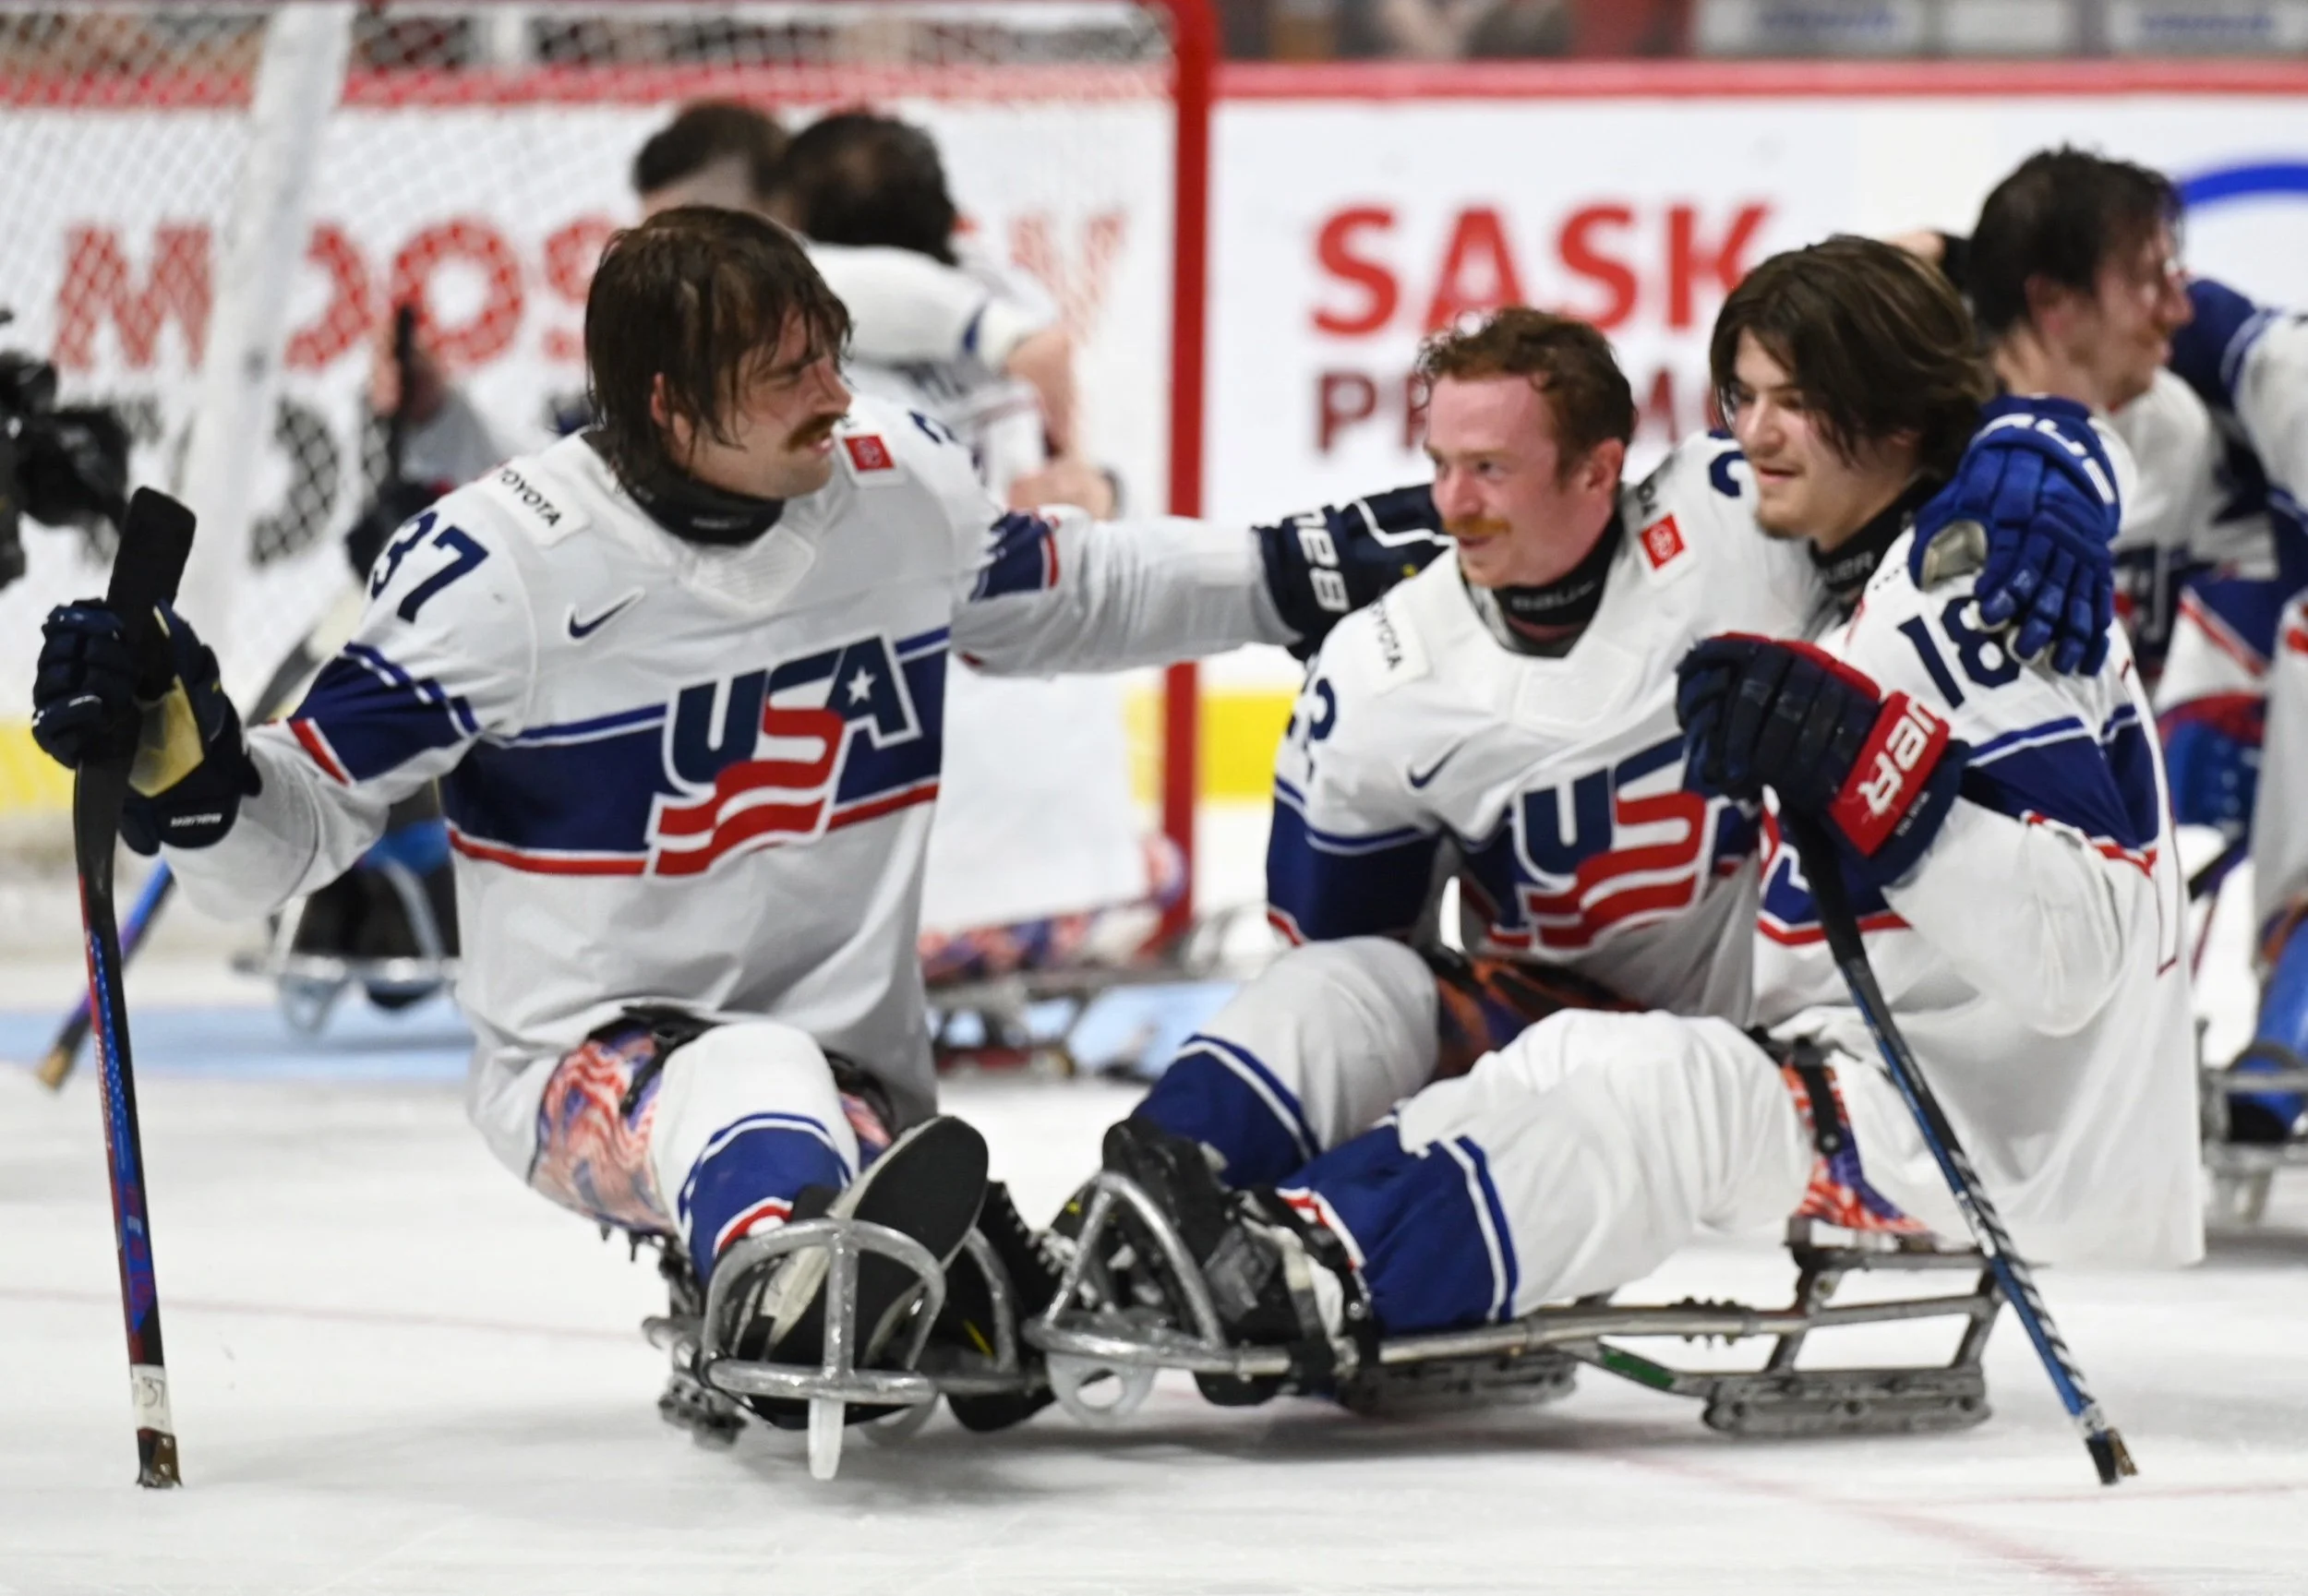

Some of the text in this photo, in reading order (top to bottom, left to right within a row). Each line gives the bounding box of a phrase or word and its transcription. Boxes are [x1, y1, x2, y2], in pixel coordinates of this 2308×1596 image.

[501, 468, 562, 527] OYOTA
[1897, 596, 2021, 710] 18
[646, 628, 921, 878] USA
[1515, 735, 1713, 954] US
